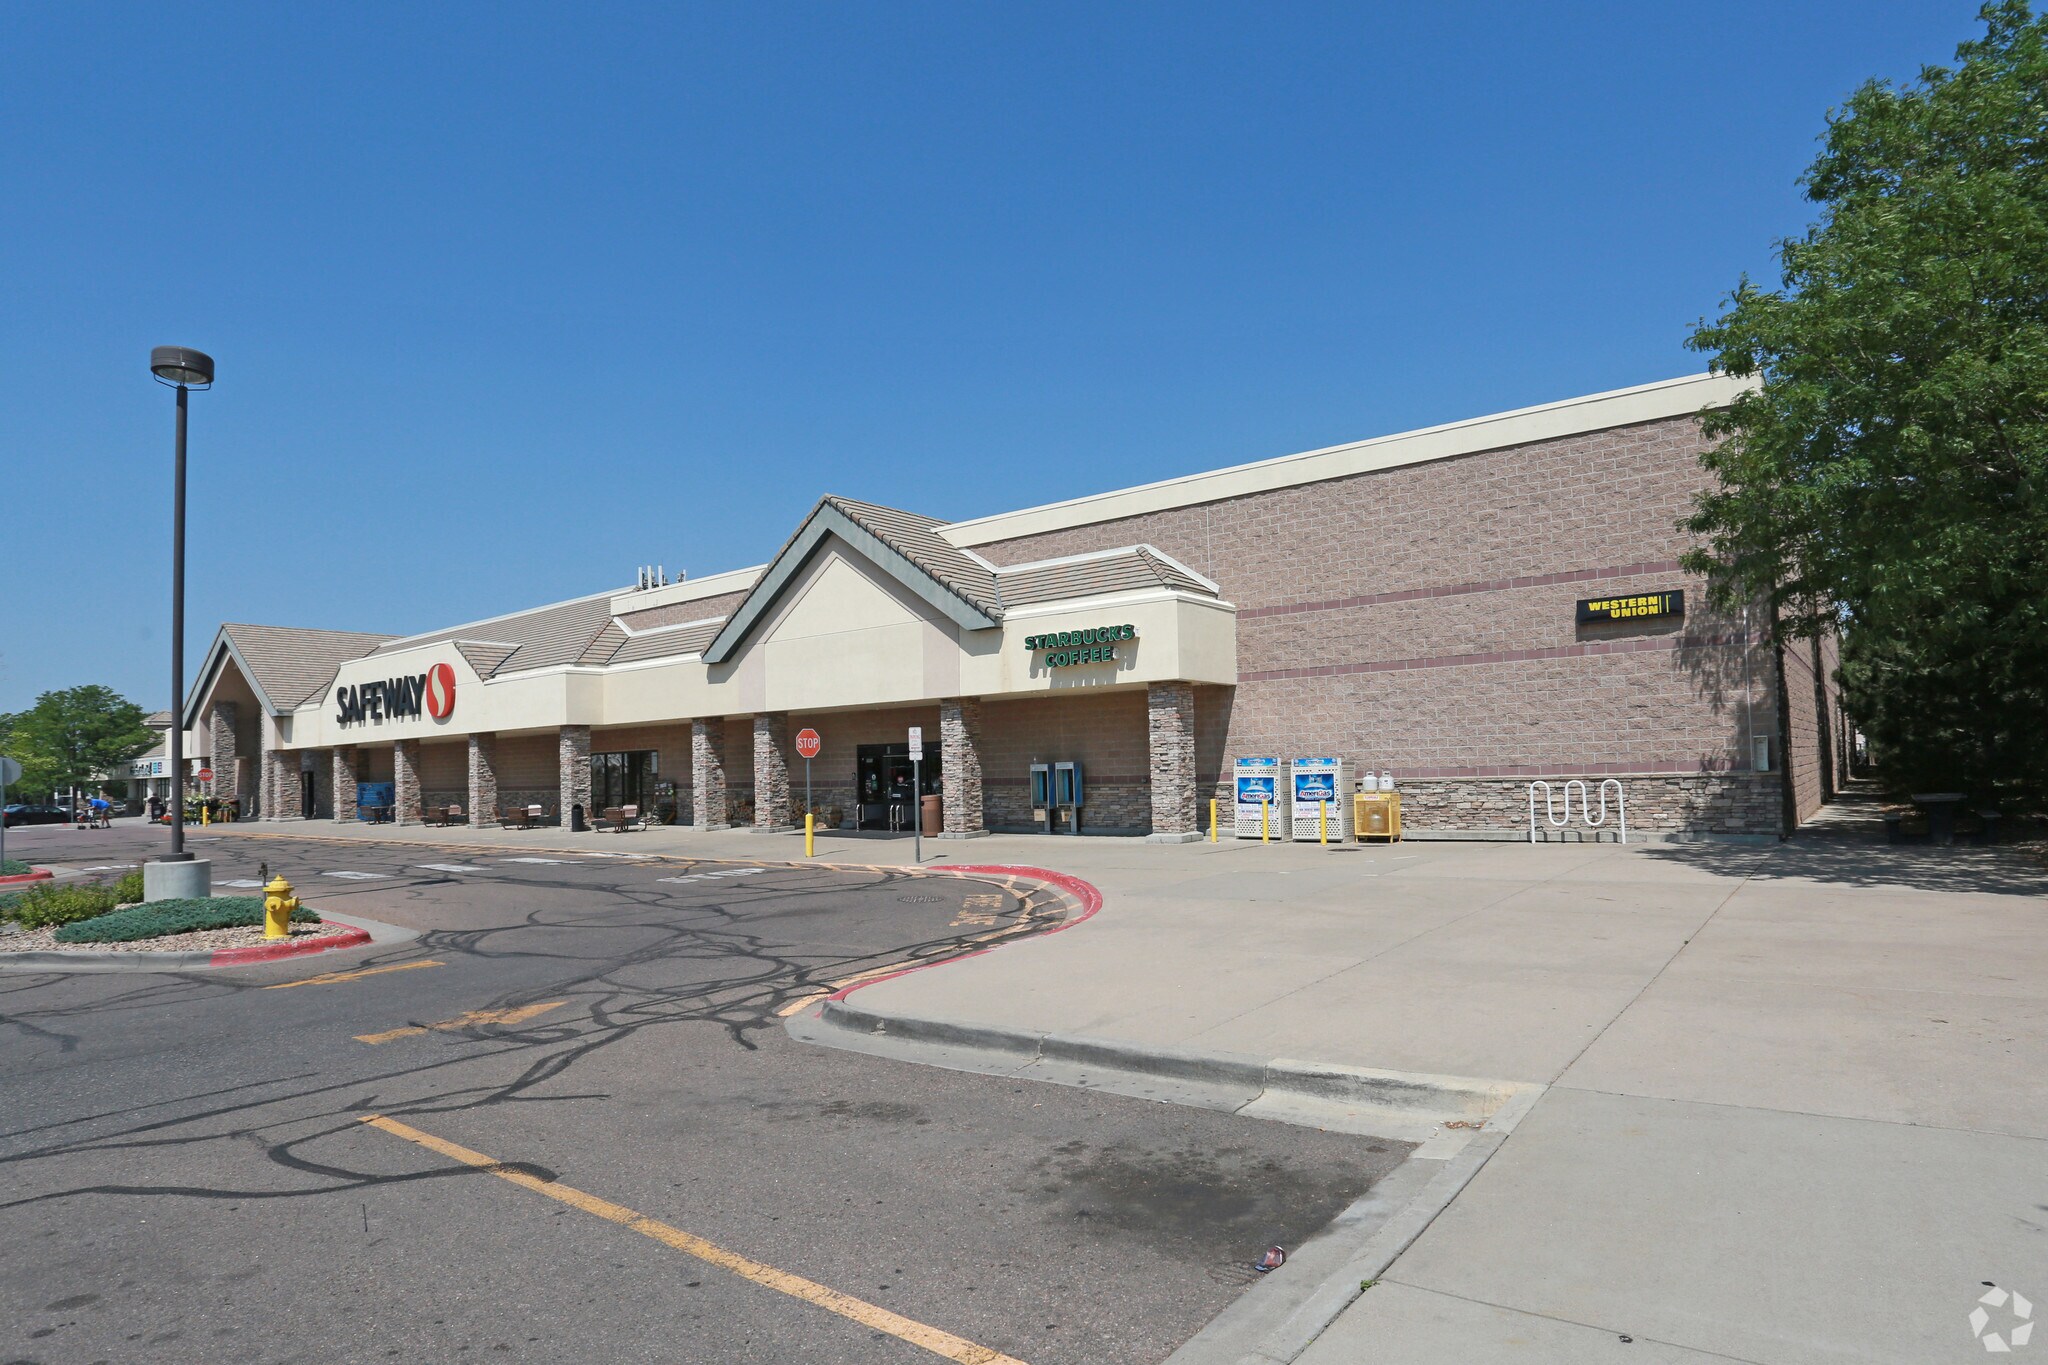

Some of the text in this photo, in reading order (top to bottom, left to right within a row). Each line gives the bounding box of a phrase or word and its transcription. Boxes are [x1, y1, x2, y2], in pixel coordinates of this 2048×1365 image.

[1588, 595, 1658, 611] WESTERN
[1610, 605, 1658, 618] UNION
[1024, 624, 1136, 651] STARBUCKS
[1045, 645, 1115, 668] COFFEE
[336, 673, 427, 724] SAFEWAY
[797, 738, 819, 749] STOP
